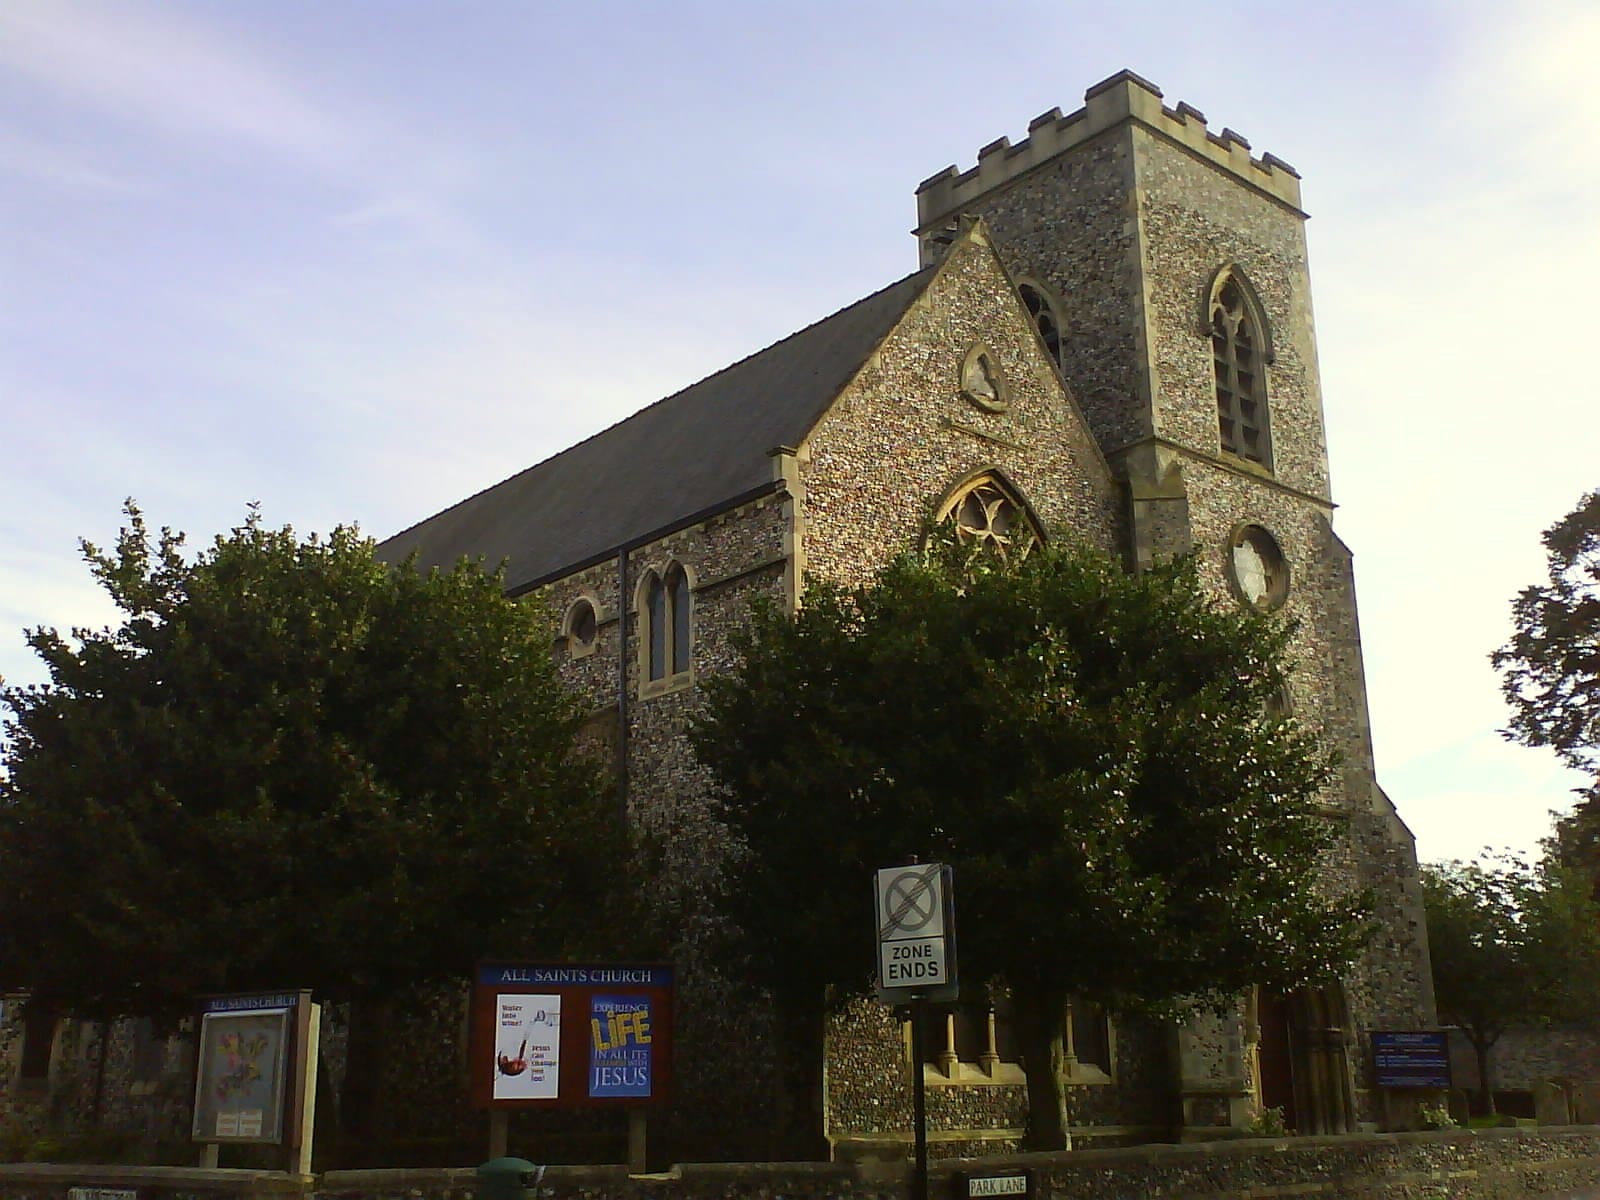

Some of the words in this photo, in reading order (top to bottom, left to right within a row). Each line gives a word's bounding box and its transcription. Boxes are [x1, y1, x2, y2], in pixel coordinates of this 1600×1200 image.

[892, 944, 932, 960] ZONE
[502, 969, 530, 982] ALL
[535, 969, 587, 982] SAINTS
[590, 970, 651, 983] CHURCH
[889, 961, 938, 980] ENDS
[593, 1003, 648, 1012] EXPERIENCE
[594, 1049, 607, 1059] IN
[610, 1049, 627, 1059] ALL
[632, 1050, 648, 1059] ITS
[593, 1066, 648, 1090] JESUS
[970, 1179, 997, 1196] PARK
[1000, 1177, 1025, 1193] LANE
